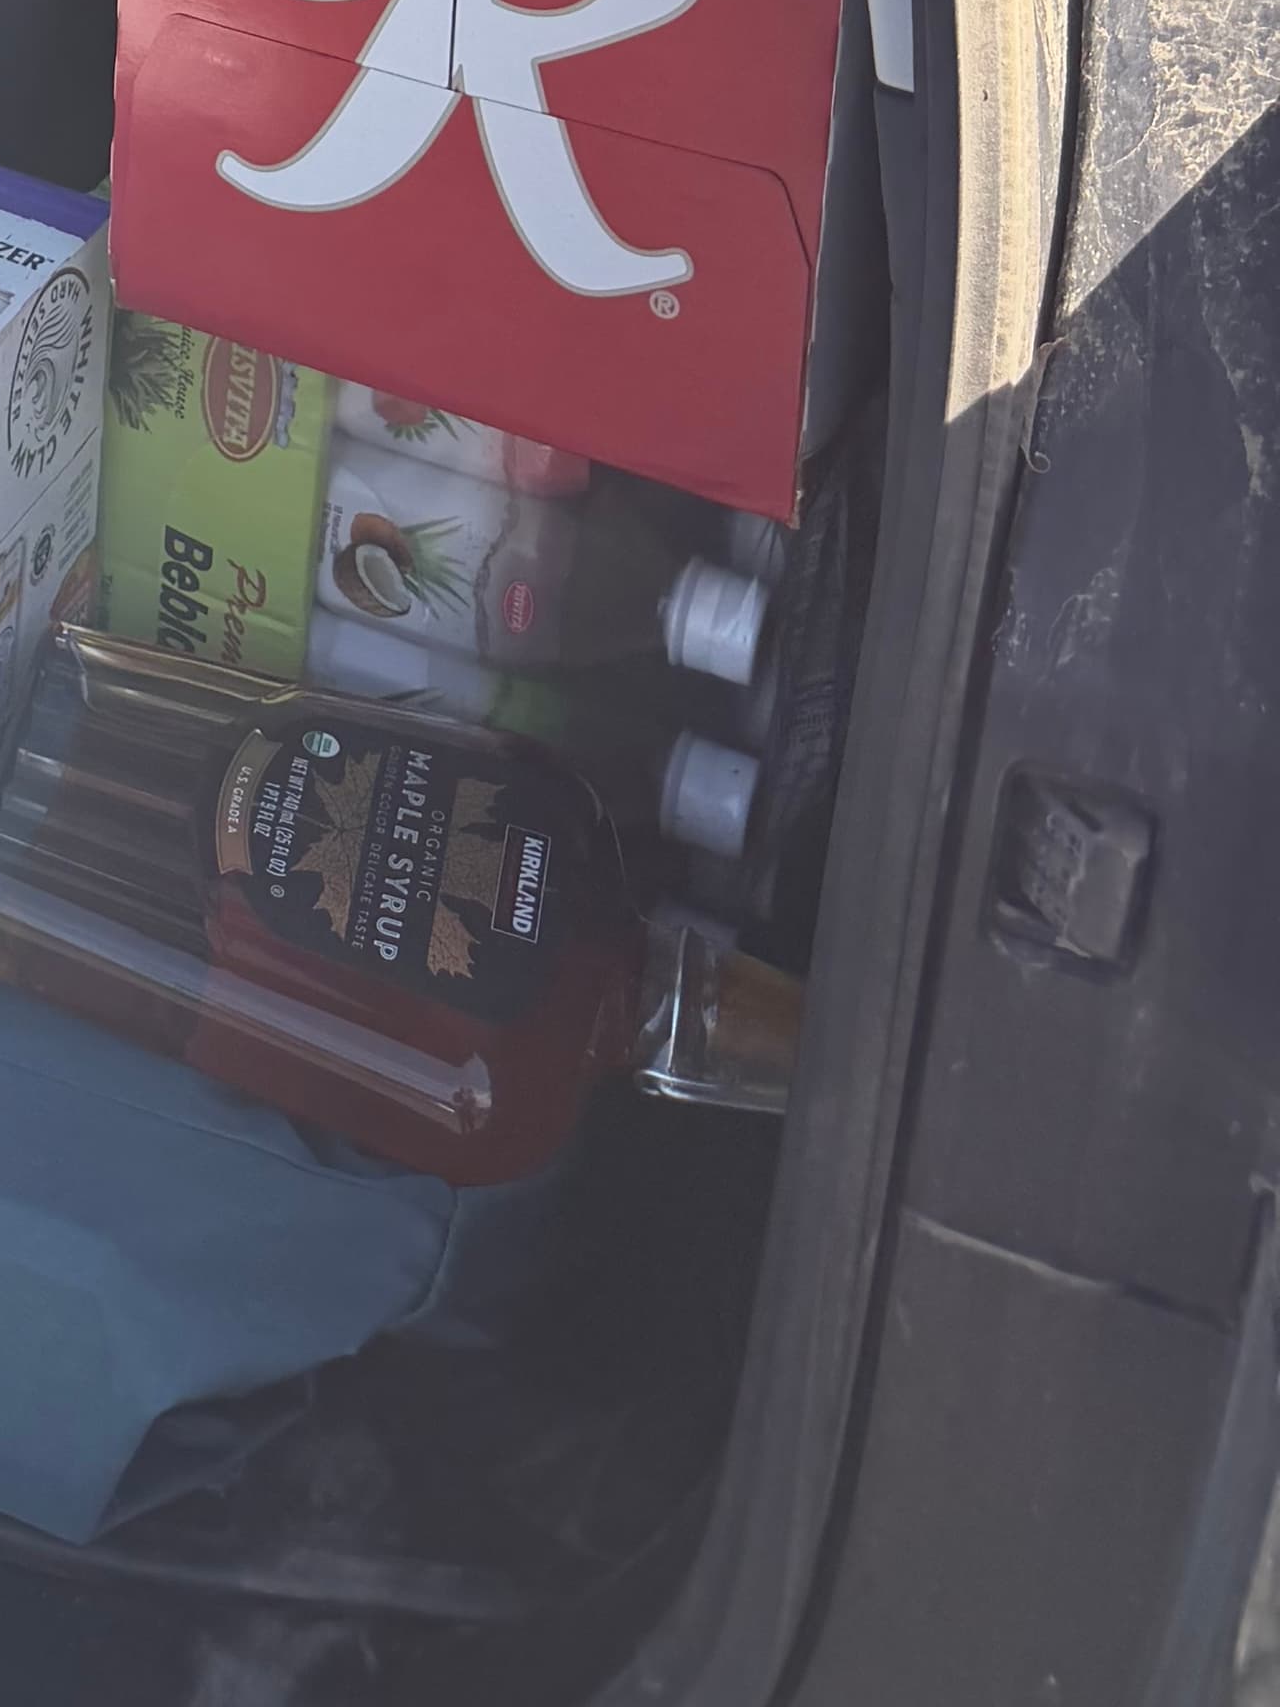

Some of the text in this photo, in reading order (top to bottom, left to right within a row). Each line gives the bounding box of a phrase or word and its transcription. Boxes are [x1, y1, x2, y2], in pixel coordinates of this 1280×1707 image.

[223, 341, 258, 448] ISVITA
[222, 558, 267, 663] Prem
[289, 755, 308, 775] NET
[286, 774, 304, 791] WT
[225, 764, 252, 834] U.S. GRADE A
[261, 787, 278, 801] PT
[281, 789, 301, 810] 740
[256, 810, 273, 821] FL
[259, 801, 275, 810] 9
[374, 790, 393, 835] COLOR
[252, 821, 270, 836] OZ
[271, 826, 296, 845] (25
[270, 844, 290, 858] FL
[374, 749, 433, 961] MAPLE SYRUP
[417, 810, 445, 903] ORGANIC
[265, 857, 288, 877] OZ)
[360, 843, 382, 906] DELICATE
[512, 835, 545, 935] KIRKLAND
[351, 910, 371, 951] TASTE
